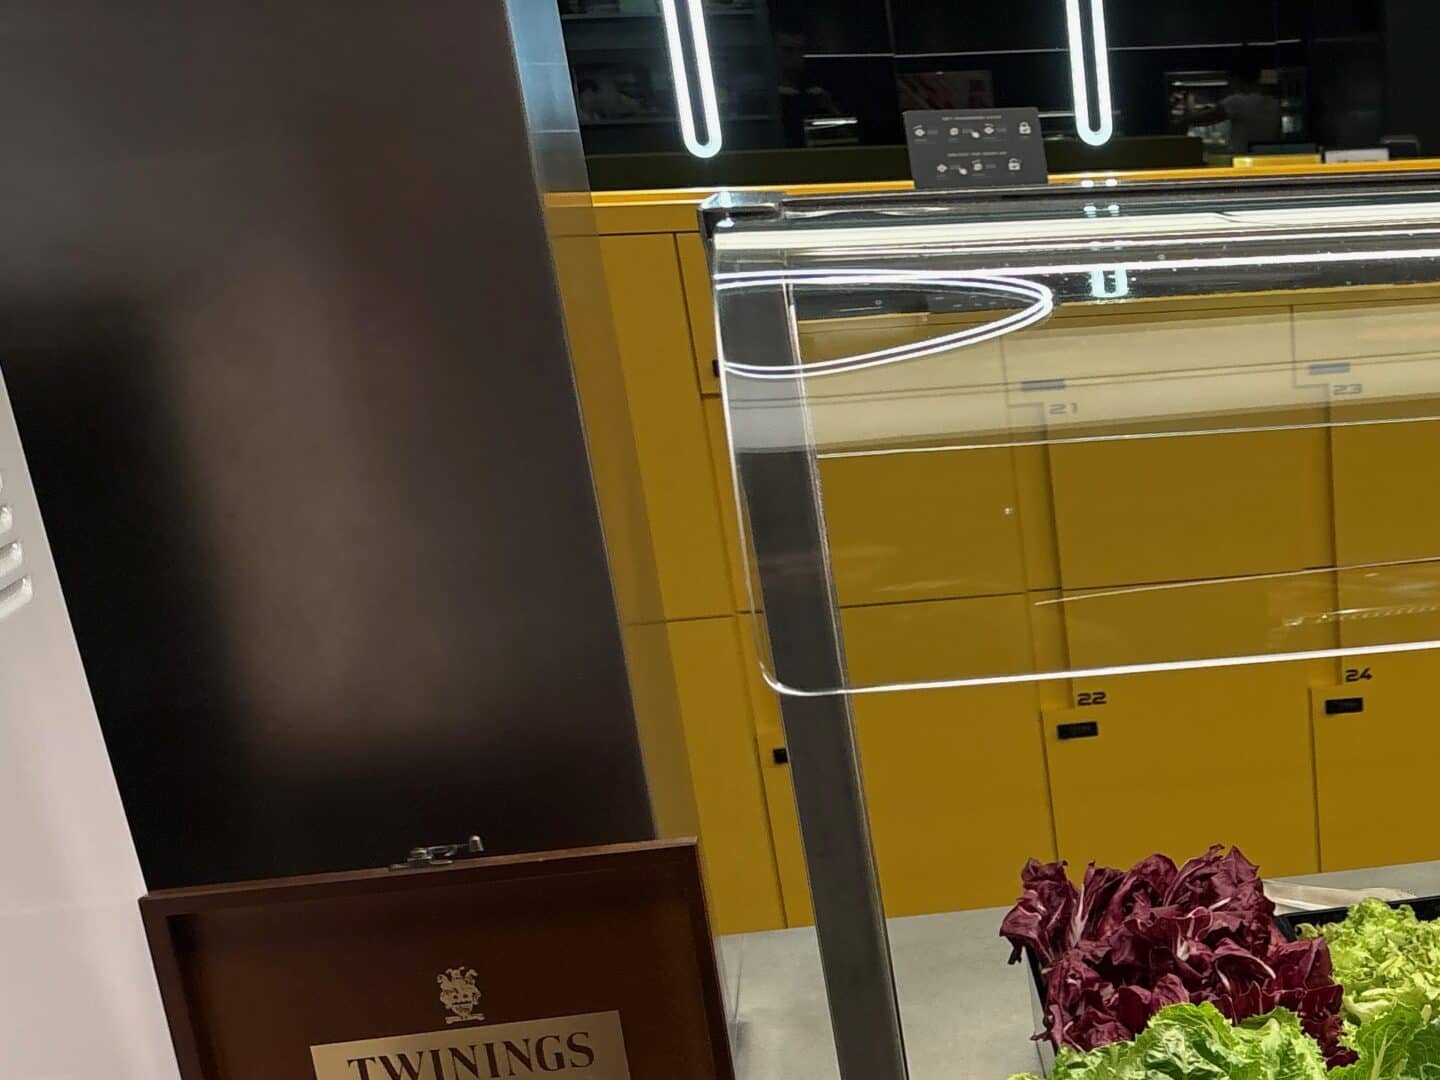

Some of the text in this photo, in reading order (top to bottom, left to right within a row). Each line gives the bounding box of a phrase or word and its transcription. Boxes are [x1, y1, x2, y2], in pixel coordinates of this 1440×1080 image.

[1332, 383, 1363, 396] 23
[1049, 402, 1078, 415] 21
[1345, 667, 1373, 682] 24
[1077, 691, 1107, 706] 22
